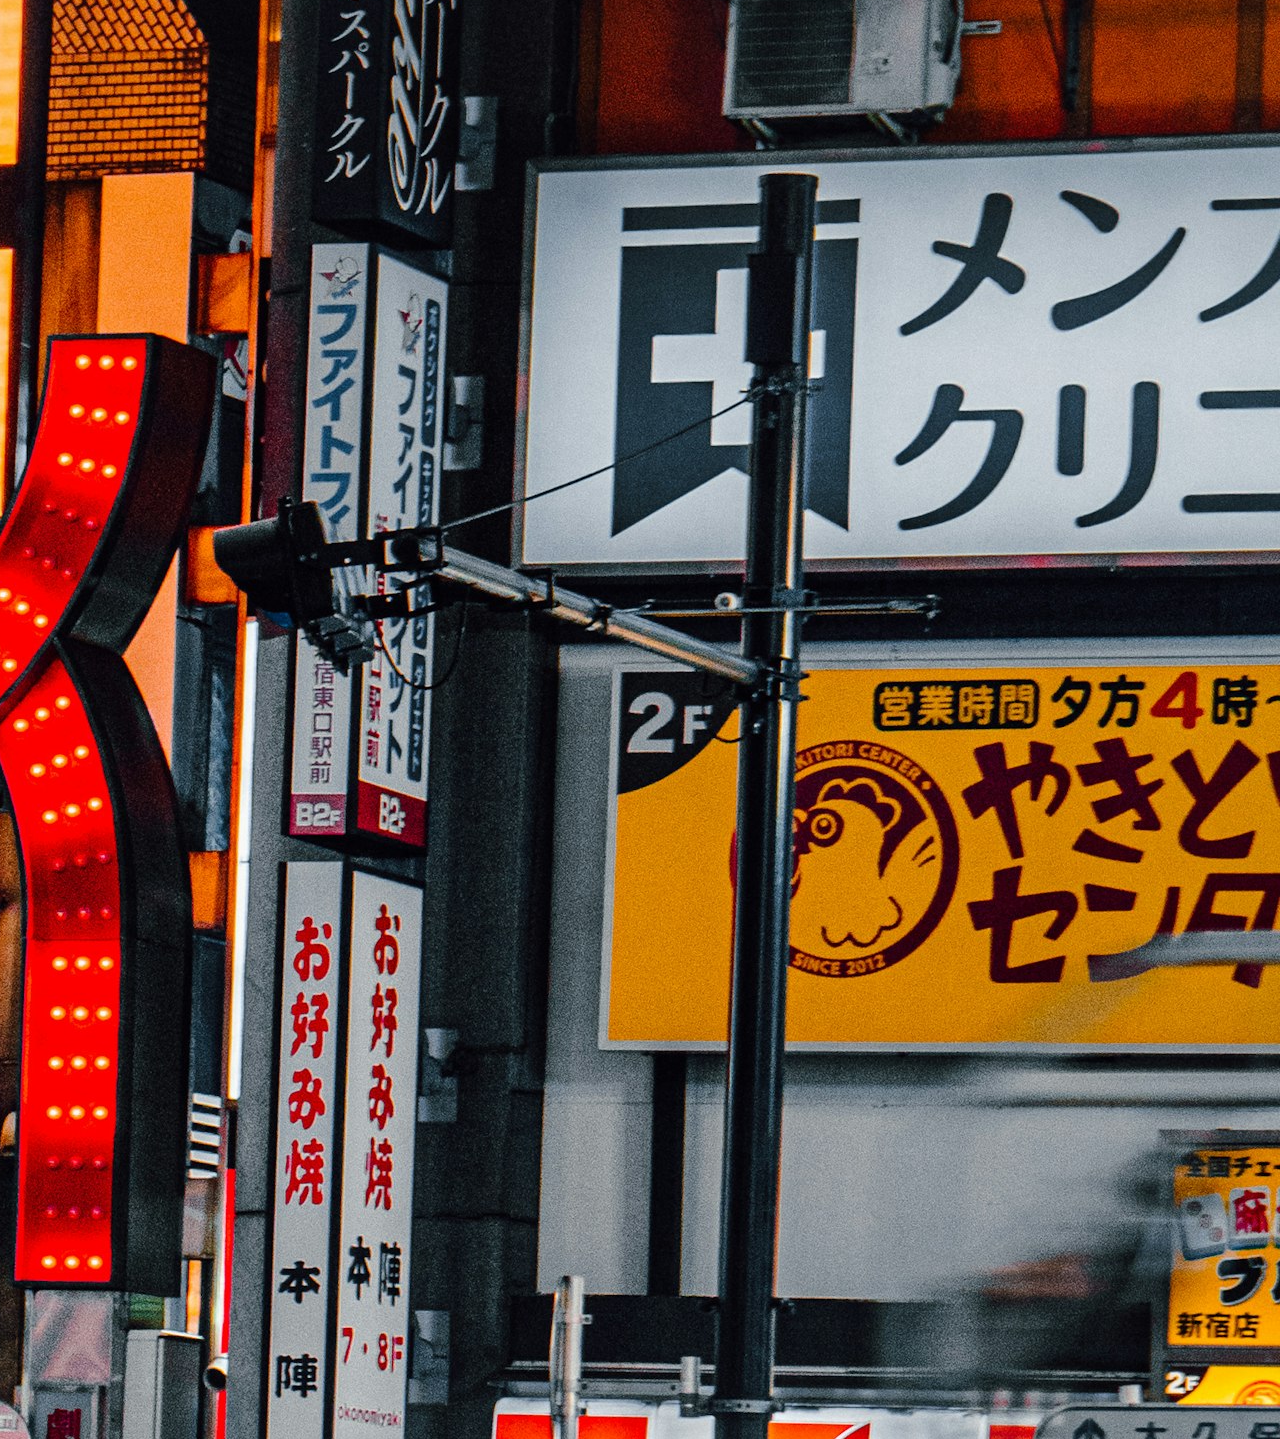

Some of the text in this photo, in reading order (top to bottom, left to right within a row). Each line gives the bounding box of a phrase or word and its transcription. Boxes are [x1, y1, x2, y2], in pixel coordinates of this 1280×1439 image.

[325, 11, 372, 184] スパークル
[309, 647, 336, 785] 宿東口駅前
[627, 692, 712, 754] 2F
[879, 685, 1037, 726] 営業時間
[859, 744, 922, 782] CENTER
[295, 801, 341, 828] B2F
[962, 738, 1280, 864] やきと
[792, 952, 887, 975] SINCE 2012
[364, 903, 401, 1210] お好み焼
[276, 916, 333, 1398] お好み焼 本陣
[347, 1236, 402, 1306] 本陣
[1216, 1255, 1280, 1306] フ
[1176, 1310, 1260, 1339] 新宿店
[1166, 1370, 1201, 1395] 2F
[337, 1405, 403, 1427] okonomiyaki
